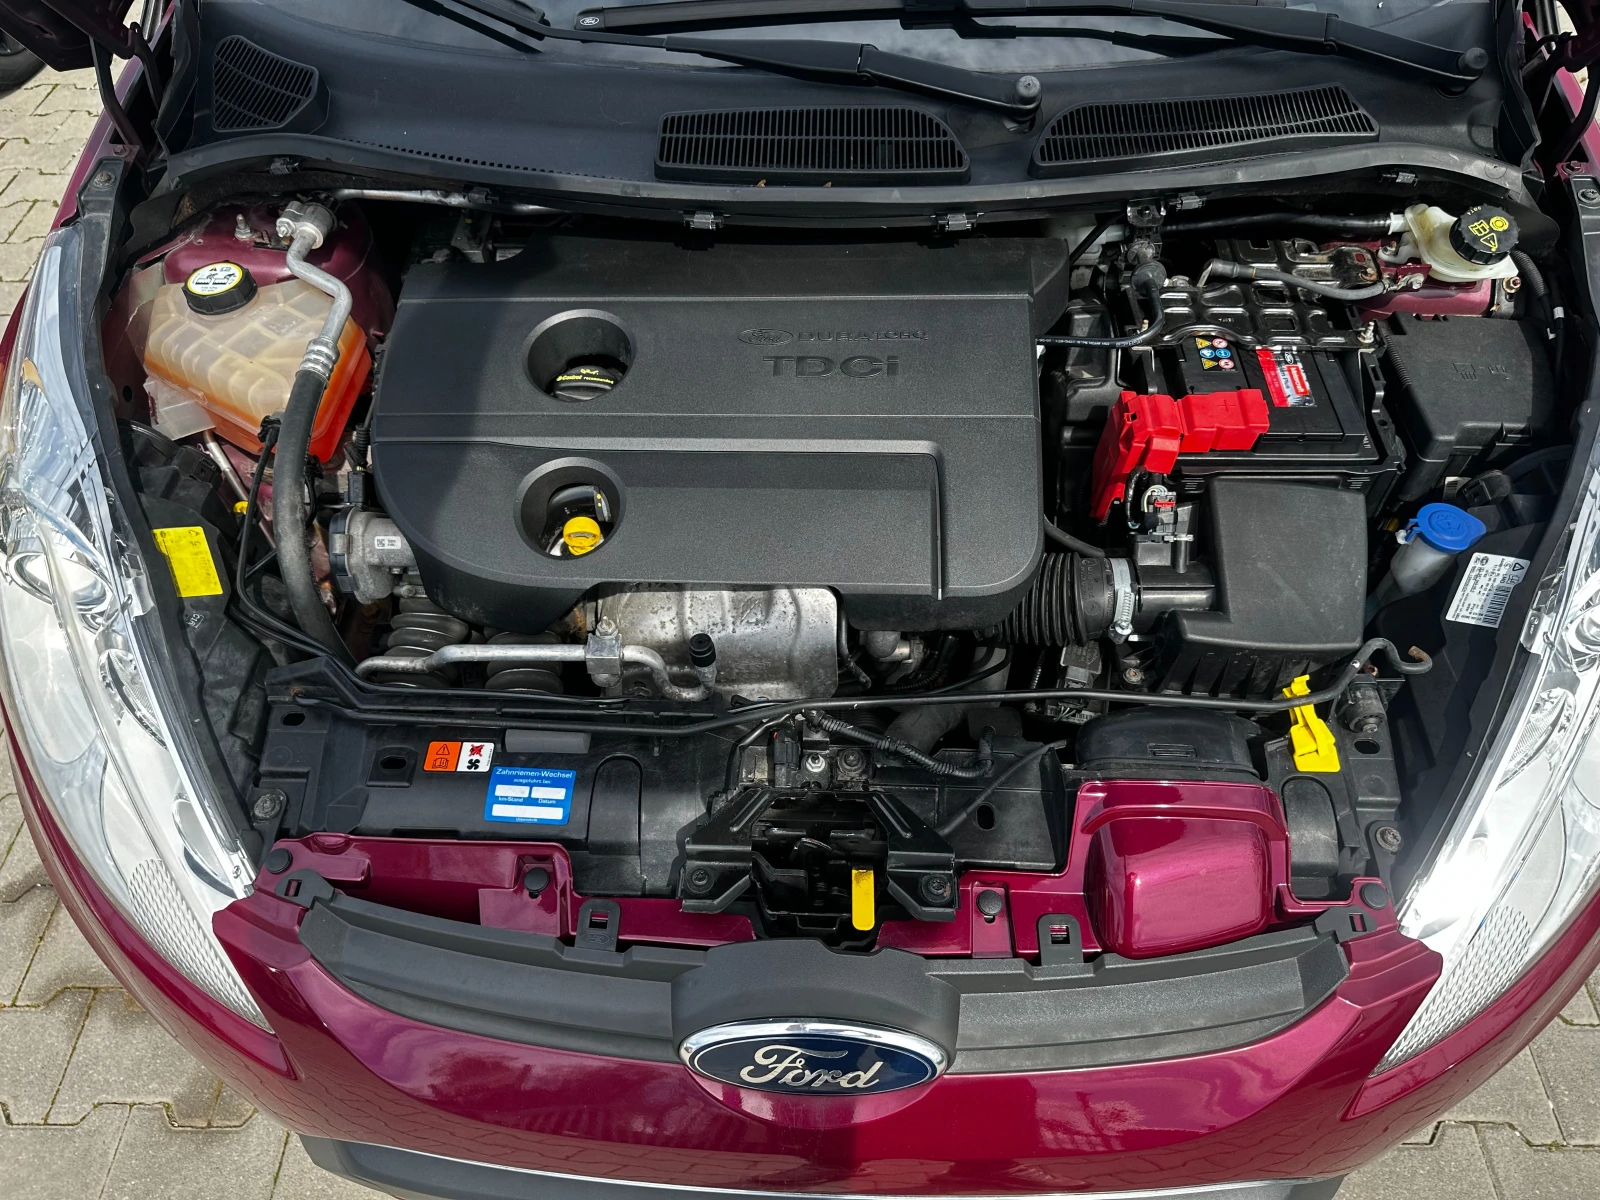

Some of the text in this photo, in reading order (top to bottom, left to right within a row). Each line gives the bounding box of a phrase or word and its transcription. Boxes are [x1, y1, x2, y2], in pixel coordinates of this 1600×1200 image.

[763, 355, 899, 378] TDCi
[495, 768, 573, 779] Zahnriemen-Wechsel
[740, 1045, 879, 1088] Ford
